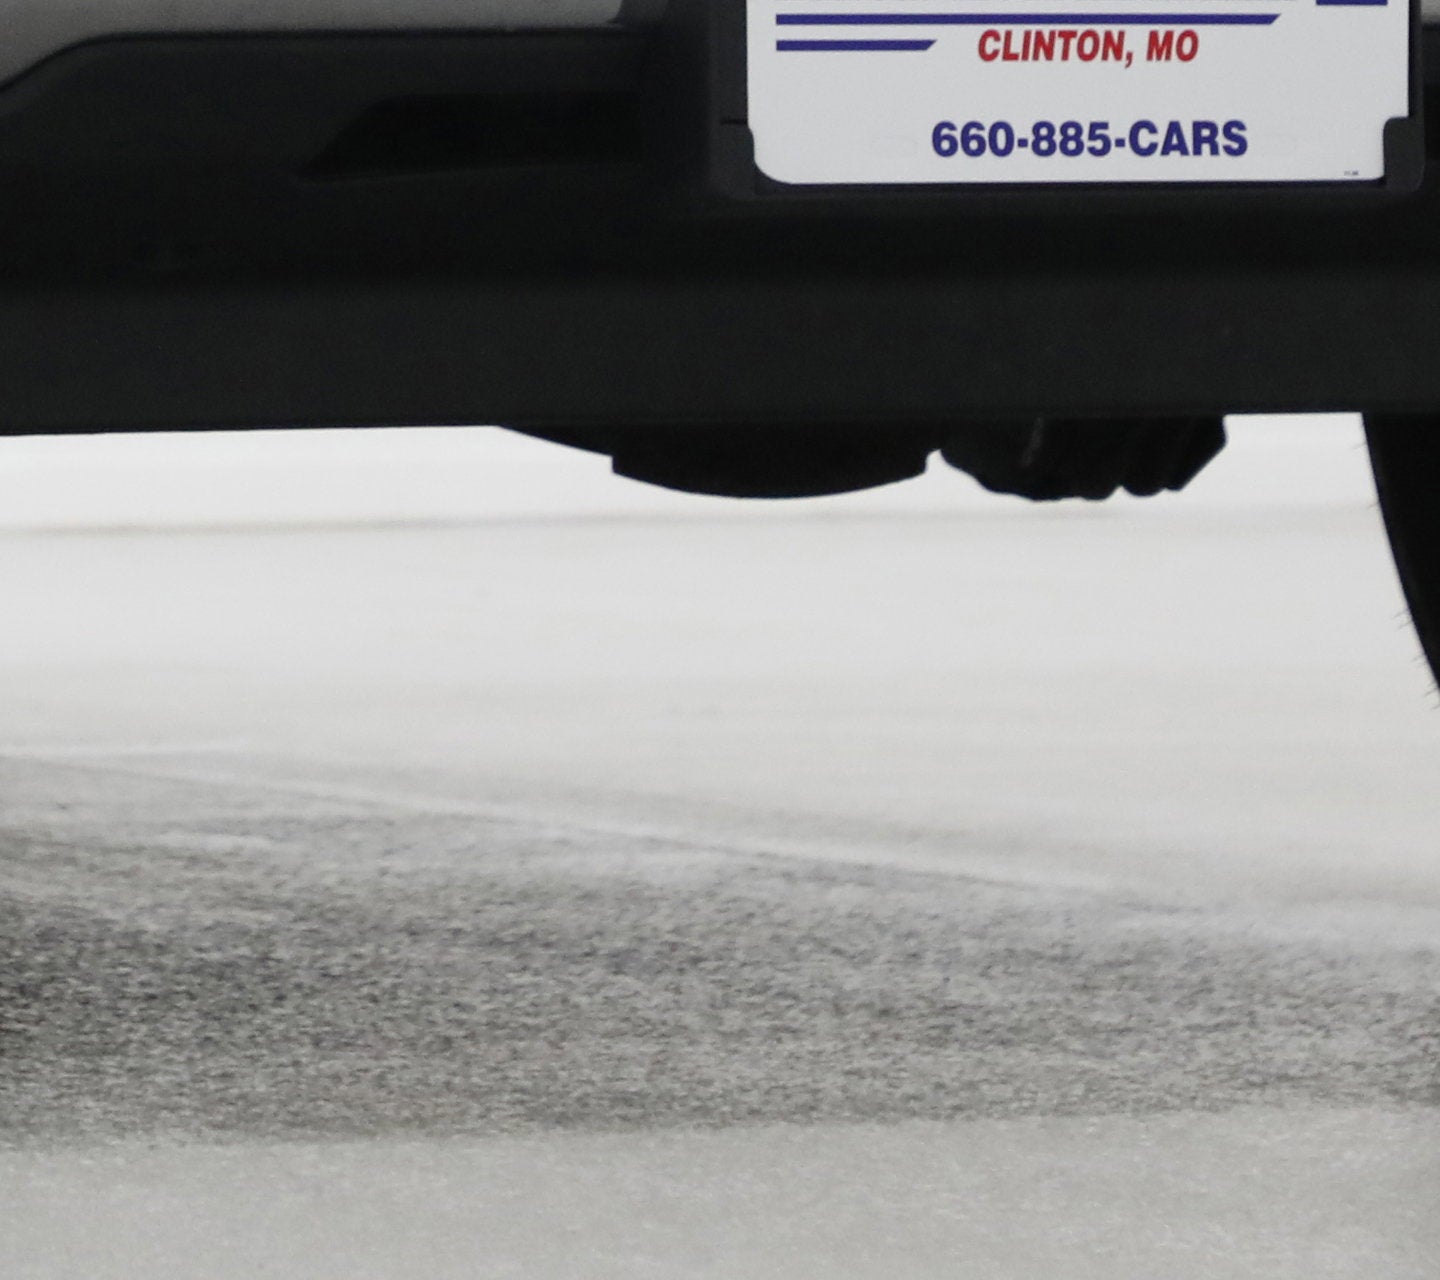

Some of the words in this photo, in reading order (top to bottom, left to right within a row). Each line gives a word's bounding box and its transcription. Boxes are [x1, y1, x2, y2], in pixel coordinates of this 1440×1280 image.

[977, 29, 1134, 68] CLINTON,
[1146, 29, 1200, 63] MO
[931, 120, 1249, 158] 660-885-CARS
